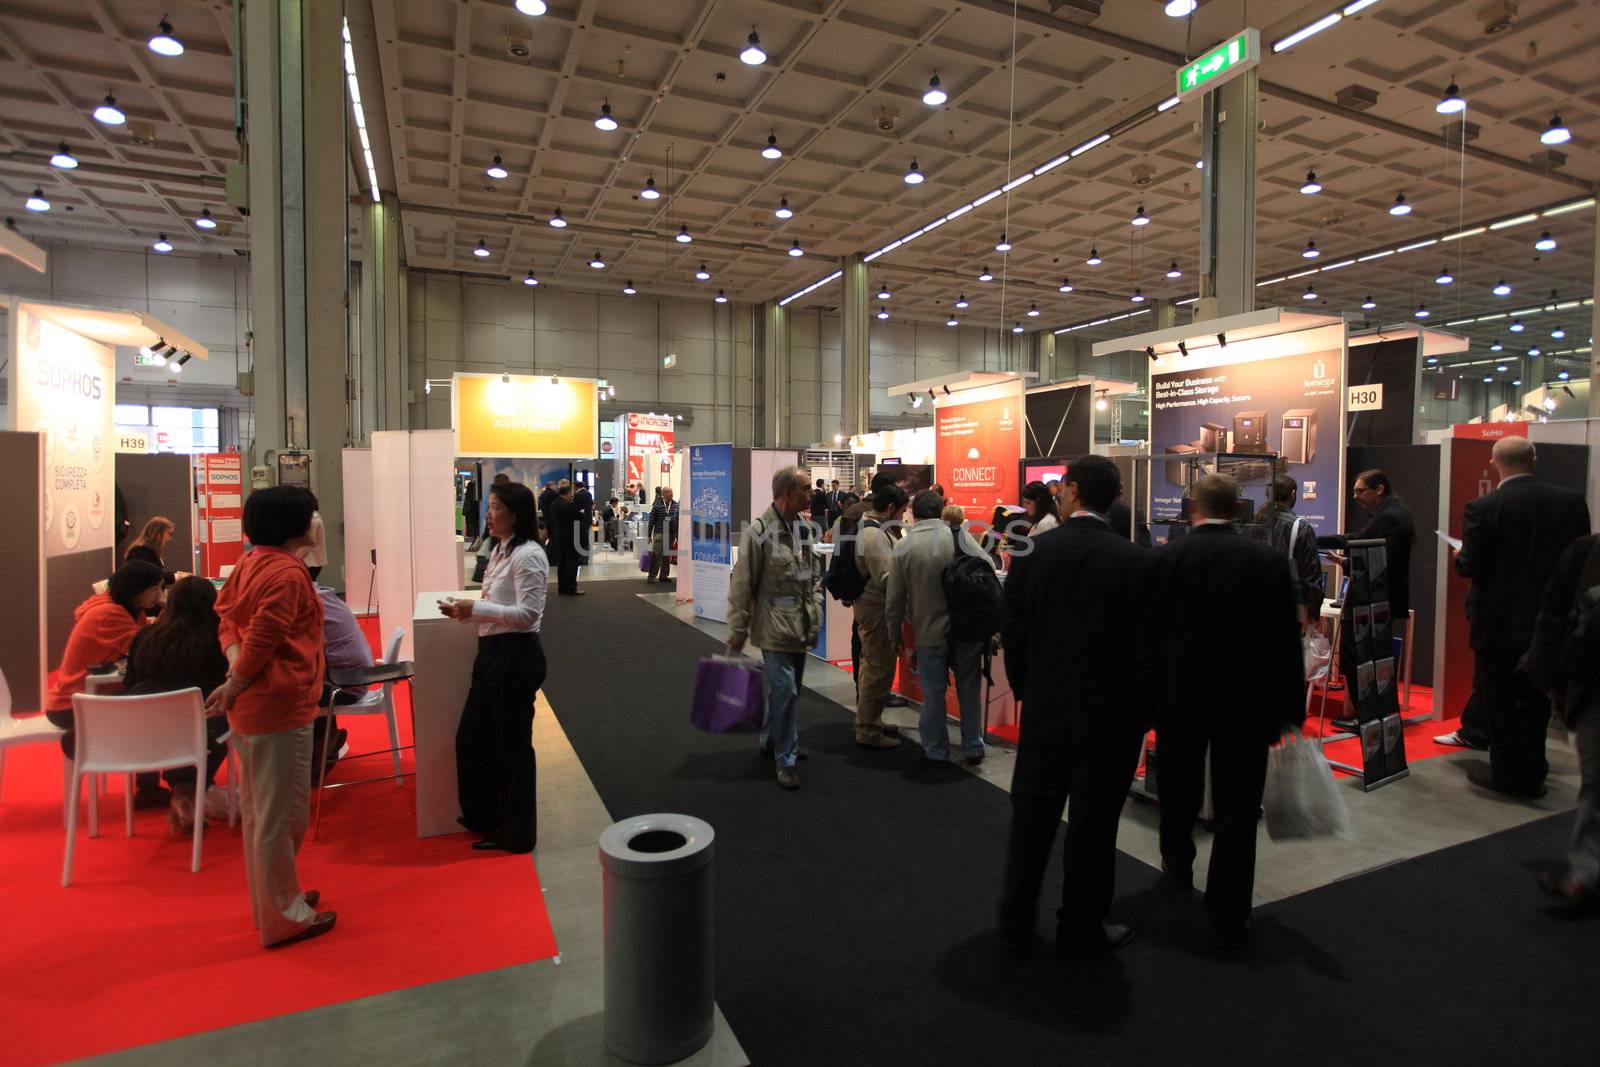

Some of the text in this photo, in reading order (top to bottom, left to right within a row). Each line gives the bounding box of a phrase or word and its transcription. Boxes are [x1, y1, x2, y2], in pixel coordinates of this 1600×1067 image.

[38, 359, 102, 400] SOPHOS
[1155, 381, 1170, 390] Build
[1171, 380, 1184, 388] Your
[1185, 377, 1213, 387] Business
[1155, 385, 1219, 399] Best-in-Class Storage
[1351, 391, 1377, 405] H30
[1155, 402, 1165, 410] High
[1166, 400, 1196, 408] Performance.
[1197, 397, 1208, 406] High
[120, 438, 145, 449] H39
[54, 465, 87, 478] SICUREZZA
[210, 473, 239, 481] SOPHOS
[953, 465, 997, 482] CONNECT
[55, 479, 87, 490] COMPLETA
